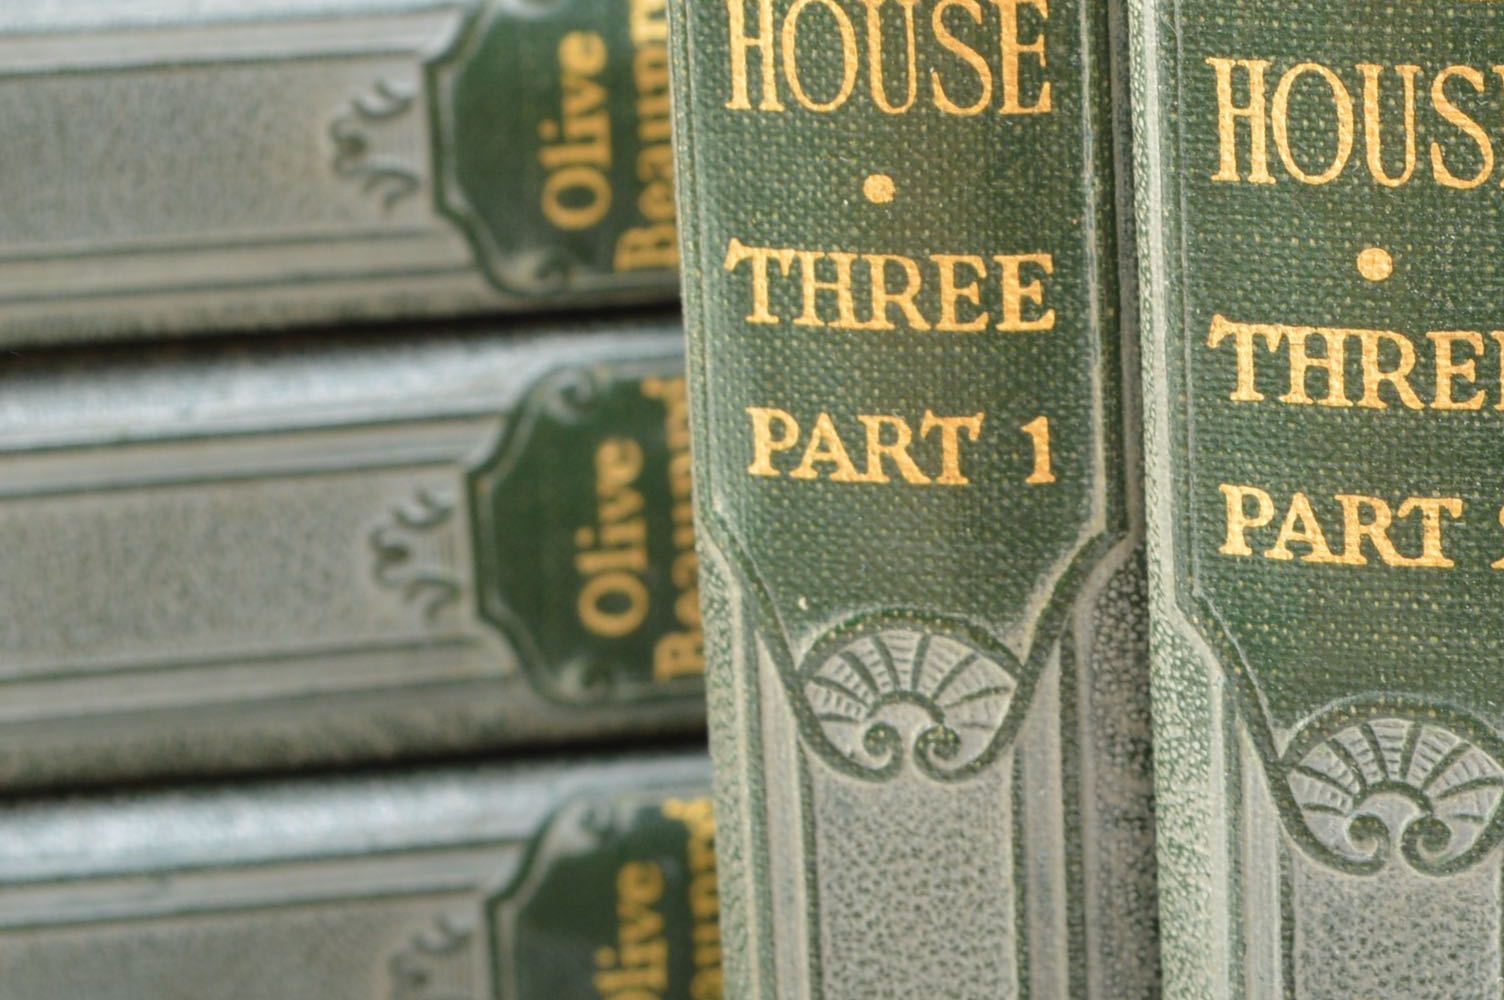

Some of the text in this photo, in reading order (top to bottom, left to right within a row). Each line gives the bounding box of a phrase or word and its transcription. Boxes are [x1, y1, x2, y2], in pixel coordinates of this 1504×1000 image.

[538, 30, 612, 230] Olive
[725, 237, 1055, 333] THREE
[747, 407, 1056, 486] PART 1
[575, 437, 648, 636] Olive
[1218, 482, 1463, 568] PART
[594, 860, 668, 1000] live
